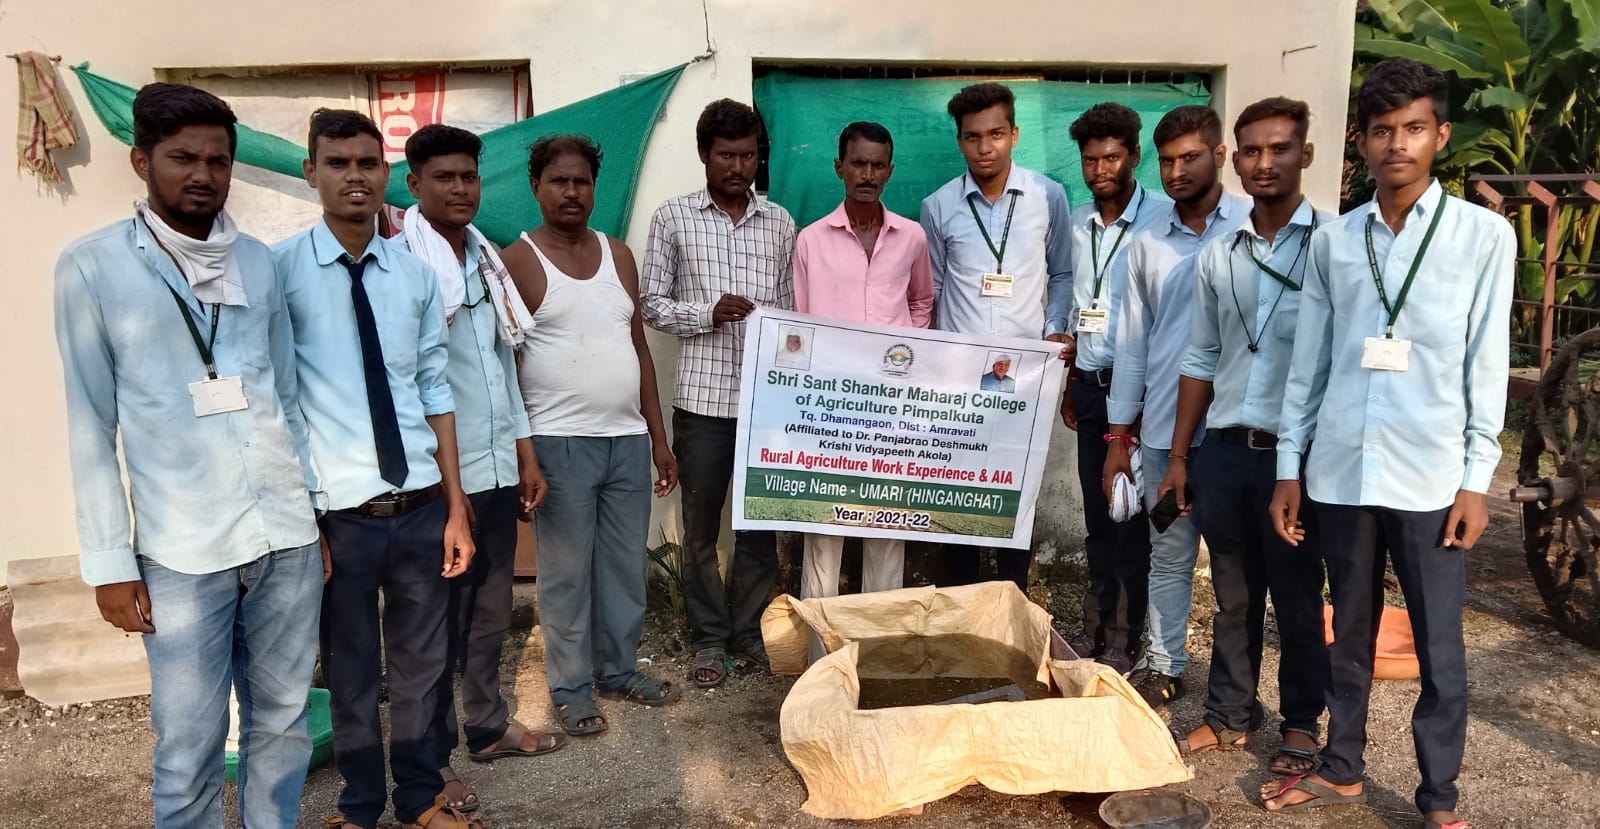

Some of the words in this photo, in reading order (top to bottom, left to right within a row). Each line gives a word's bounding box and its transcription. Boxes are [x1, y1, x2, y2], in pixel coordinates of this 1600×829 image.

[767, 370, 798, 387] Shri
[803, 375, 837, 391] Sant
[841, 379, 903, 399] Shankar
[907, 386, 967, 409] Maharaj
[971, 393, 1026, 414] College
[795, 394, 812, 405] of
[815, 395, 897, 415] Agriculture
[902, 404, 984, 424] Pimpalkuta
[800, 410, 817, 423] Tq.
[820, 413, 895, 430] Dhamangaon,
[898, 421, 920, 432] Dist
[929, 424, 976, 437] Amravati
[785, 423, 838, 437] (Affiliated
[841, 430, 853, 439] to
[856, 431, 870, 441] Dr.
[874, 432, 928, 446] Panjabrao
[931, 438, 988, 452] Deshmukh
[819, 440, 851, 452] Krishi
[855, 444, 915, 458] Vidyapeeth
[917, 450, 952, 463] Akola)
[760, 447, 793, 464] Rural
[796, 451, 868, 469] Agriculture
[872, 458, 903, 475] Work
[906, 462, 975, 481] Experience
[978, 468, 988, 482] &
[991, 470, 1013, 484] AIA
[765, 474, 806, 496] Village
[809, 478, 847, 496] Name
[860, 482, 904, 502] UMARI
[907, 487, 1003, 514] (HINGANGHAT)
[834, 506, 864, 521] Year
[876, 511, 929, 526] 2021-22
